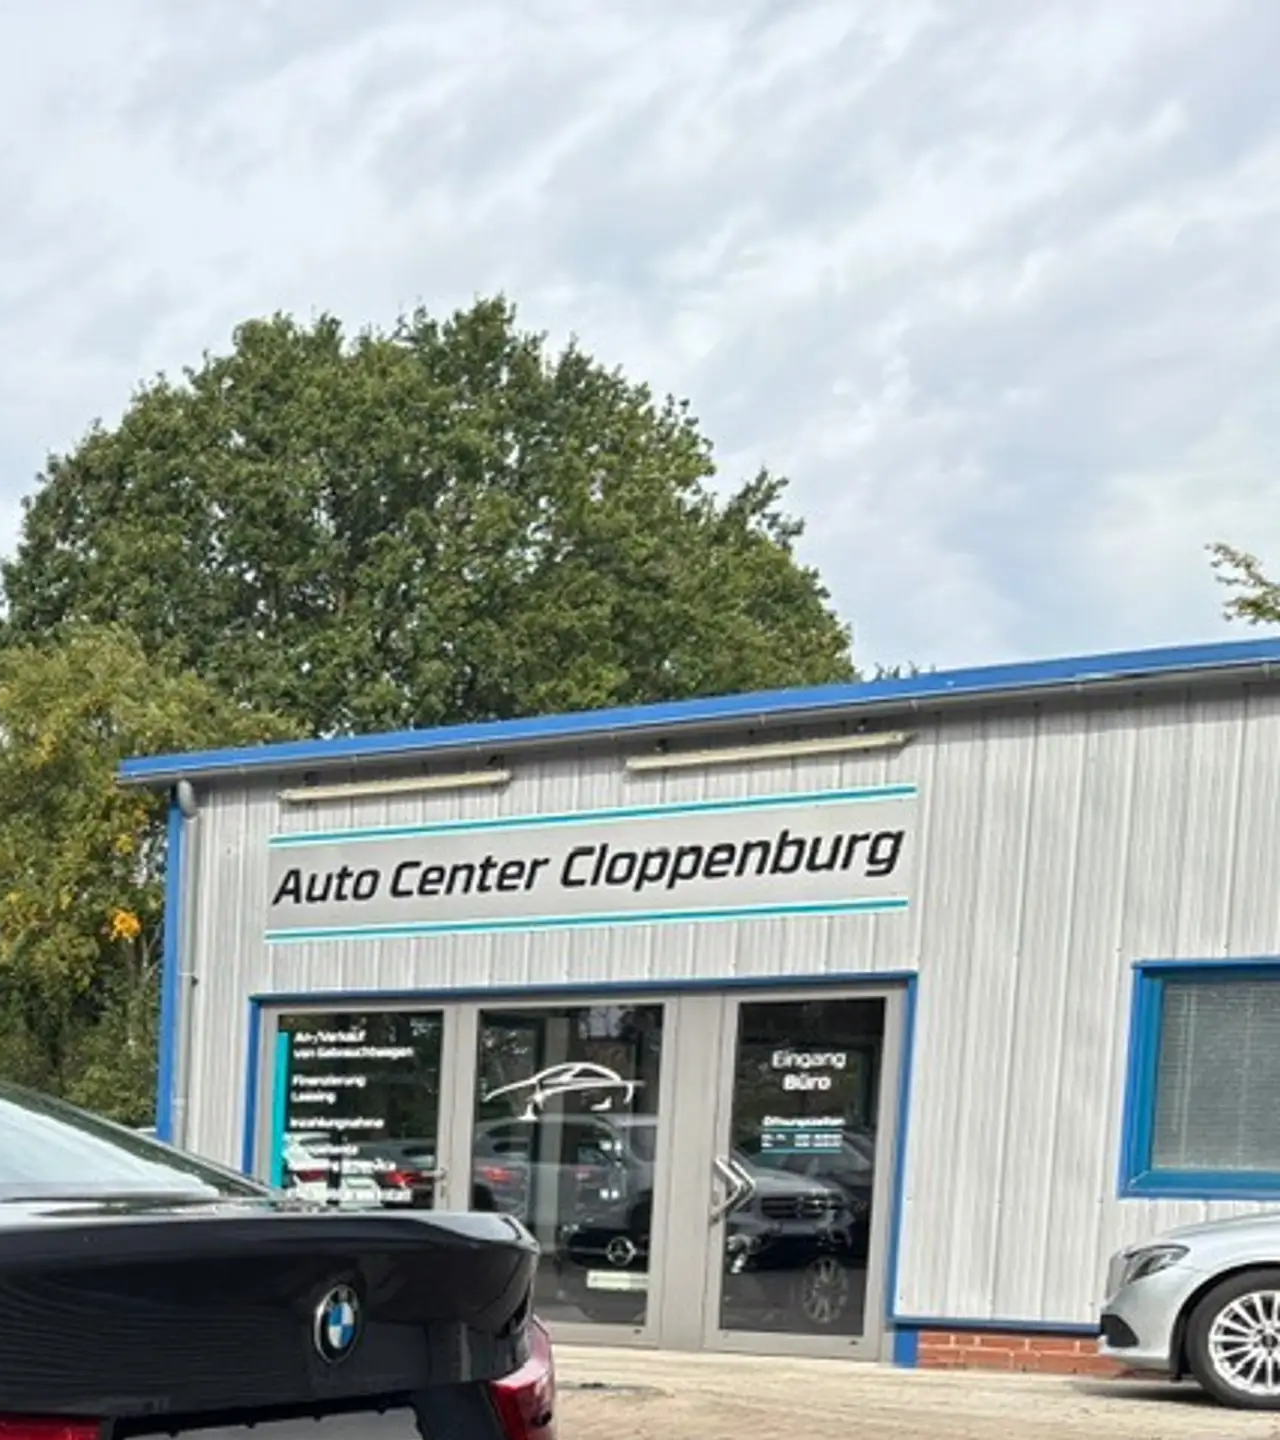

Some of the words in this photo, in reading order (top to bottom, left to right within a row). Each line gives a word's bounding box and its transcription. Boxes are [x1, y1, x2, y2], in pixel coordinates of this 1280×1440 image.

[272, 865, 381, 906] Auto
[389, 855, 551, 898] Center
[560, 829, 905, 892] Cloppenburg
[772, 1050, 847, 1070] Eingang
[783, 1072, 832, 1091] Büro
